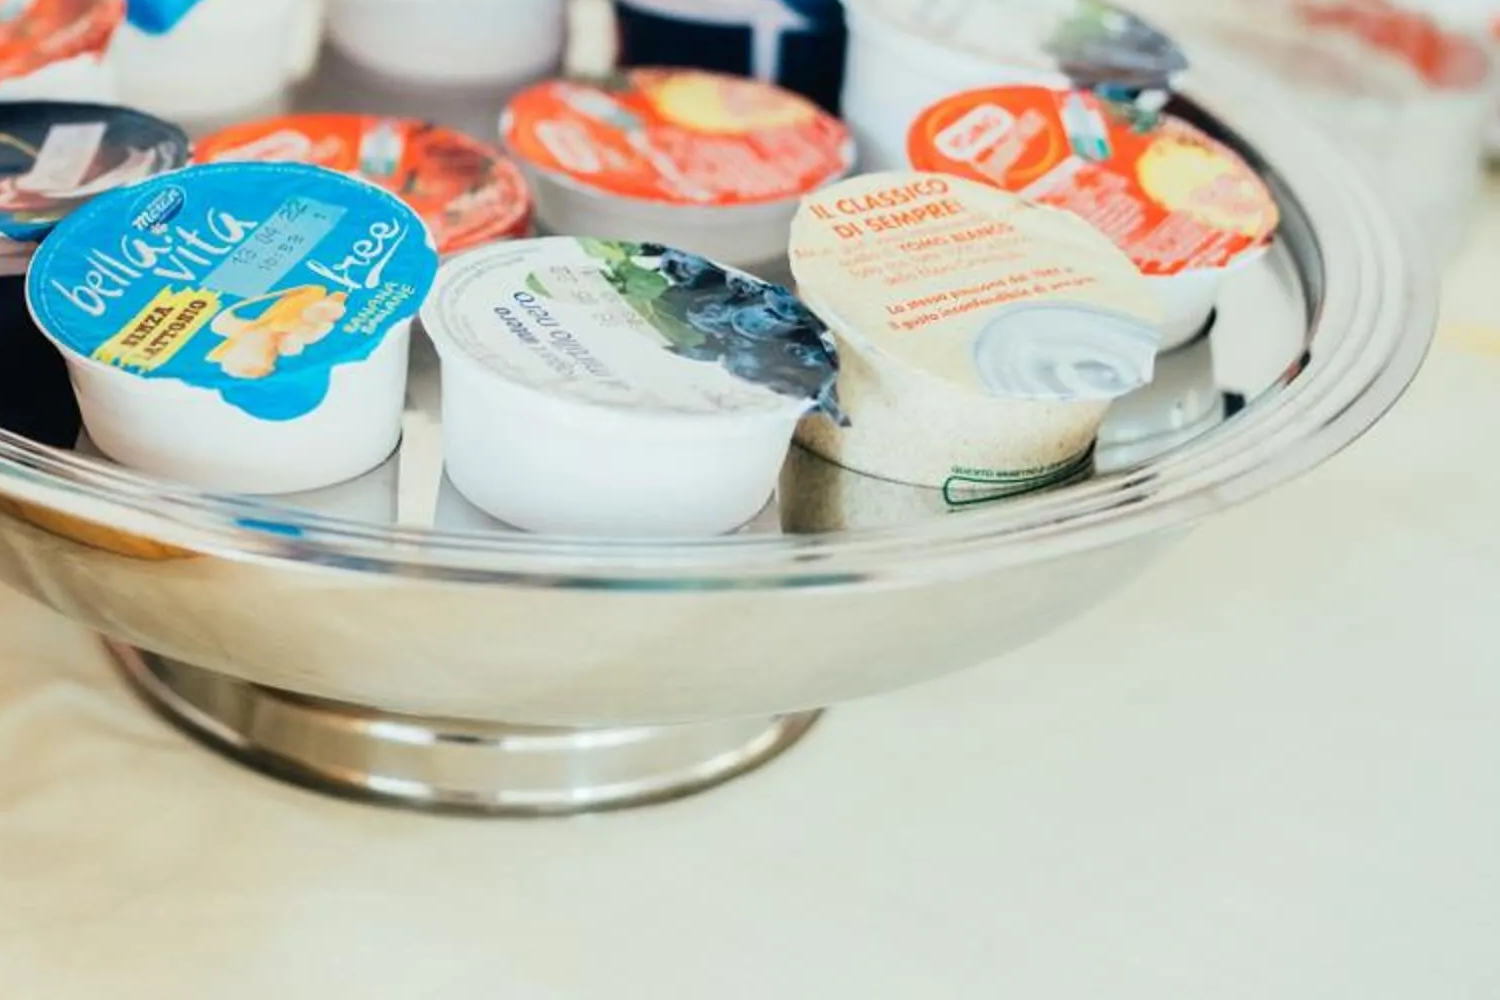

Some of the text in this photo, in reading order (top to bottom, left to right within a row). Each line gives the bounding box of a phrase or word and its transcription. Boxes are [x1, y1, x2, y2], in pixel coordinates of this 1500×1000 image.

[808, 178, 949, 220] IL CLASSICO
[153, 207, 258, 281] vita
[306, 217, 400, 293] free
[832, 220, 863, 239] DI
[51, 234, 173, 316] bella
[121, 304, 174, 347] SENZA
[139, 299, 208, 361] ATTOSIO
[513, 291, 560, 327] nero
